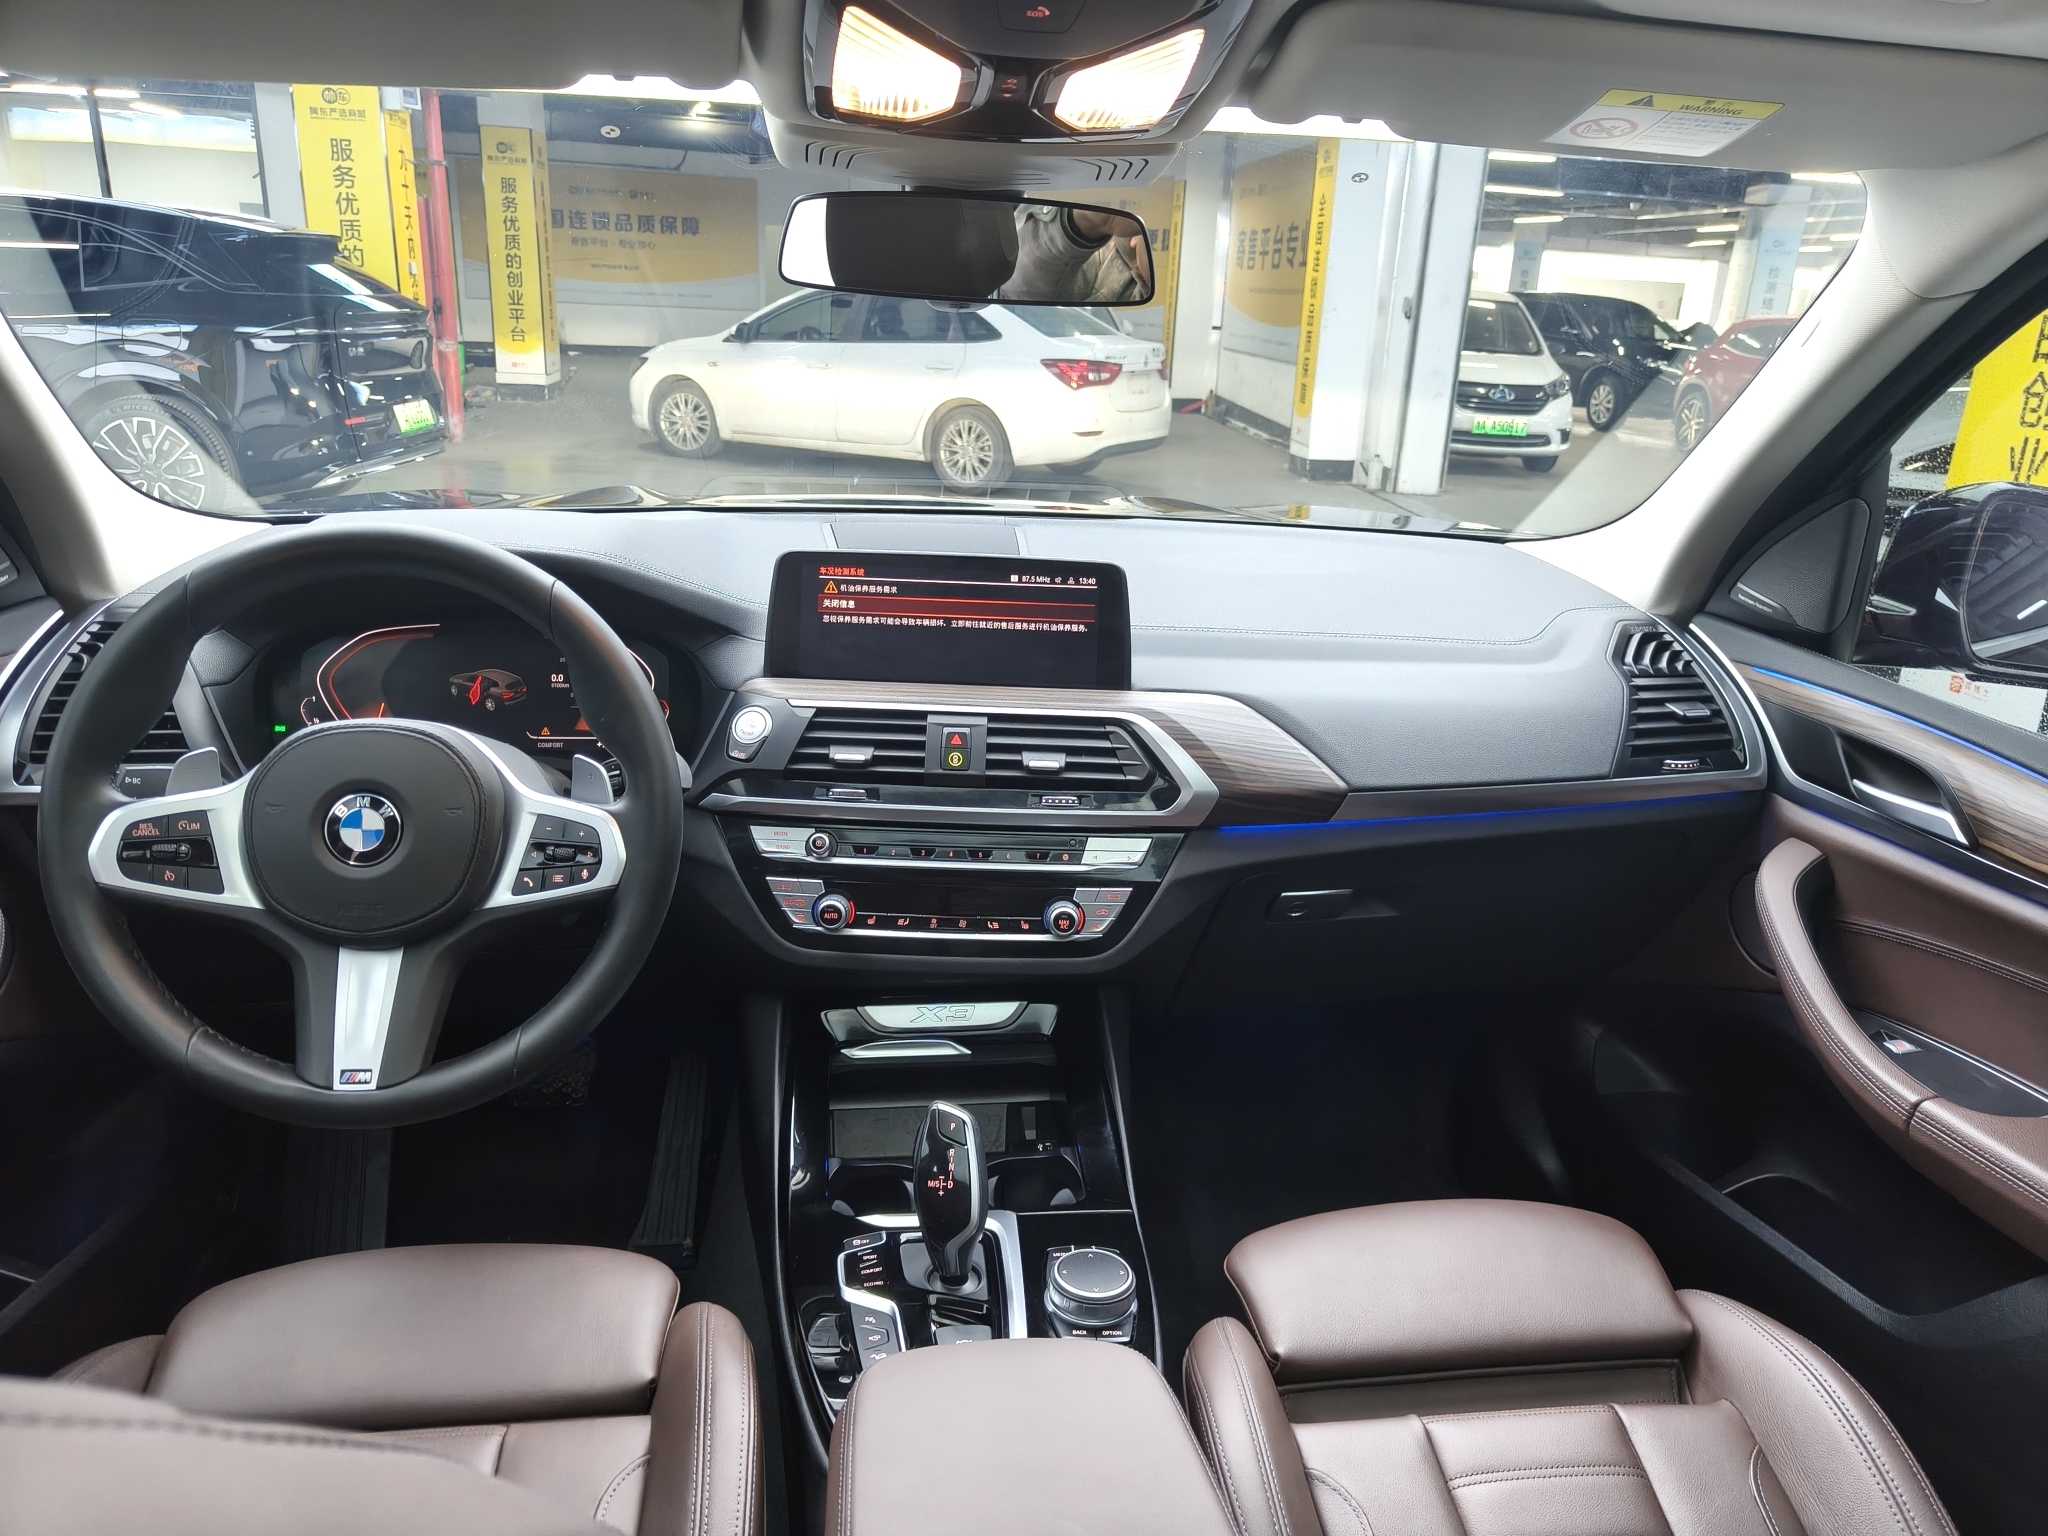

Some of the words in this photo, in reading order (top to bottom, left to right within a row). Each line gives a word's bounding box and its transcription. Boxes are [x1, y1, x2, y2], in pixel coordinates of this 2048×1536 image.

[1680, 103, 1744, 115] WARNING
[329, 137, 365, 268] 服务优质的
[500, 176, 527, 343] 服务优质的创业平台
[819, 567, 865, 576] 车况检测系统
[1021, 575, 1036, 583] 87.5
[1079, 577, 1096, 585] 13:40
[840, 583, 898, 594] 机油保养服务需求
[822, 599, 856, 609] 关闭信息
[132, 828, 160, 836] CANCEL
[909, 1004, 975, 1023] X3
